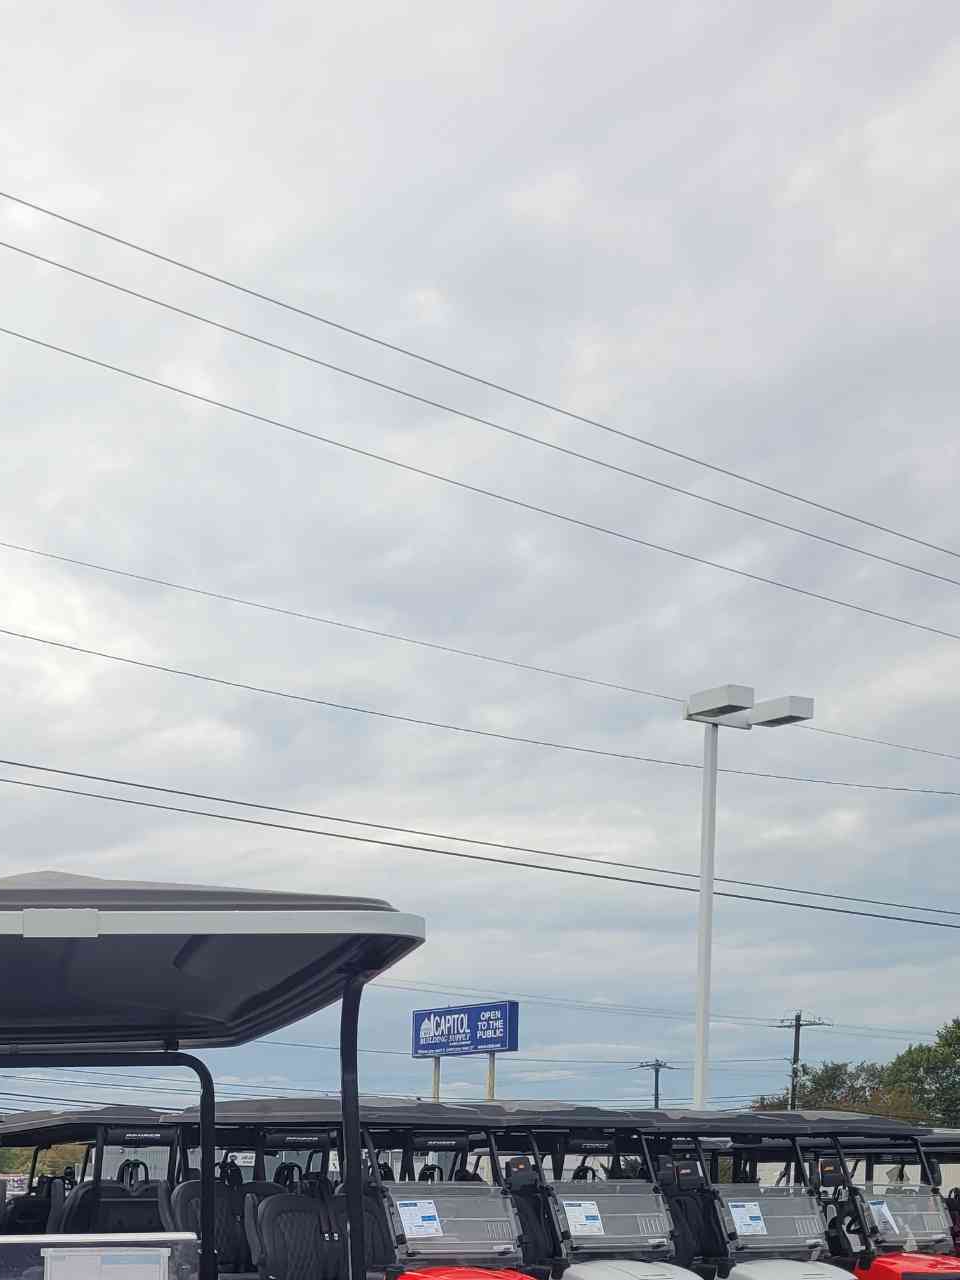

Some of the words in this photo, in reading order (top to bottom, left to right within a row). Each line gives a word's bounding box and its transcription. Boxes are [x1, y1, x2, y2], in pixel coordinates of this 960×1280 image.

[480, 1010, 501, 1020] OPEN
[433, 1013, 471, 1036] CAPITOL
[477, 1021, 488, 1030] TO
[489, 1019, 504, 1029] THE
[476, 1028, 504, 1039] PUBLIC
